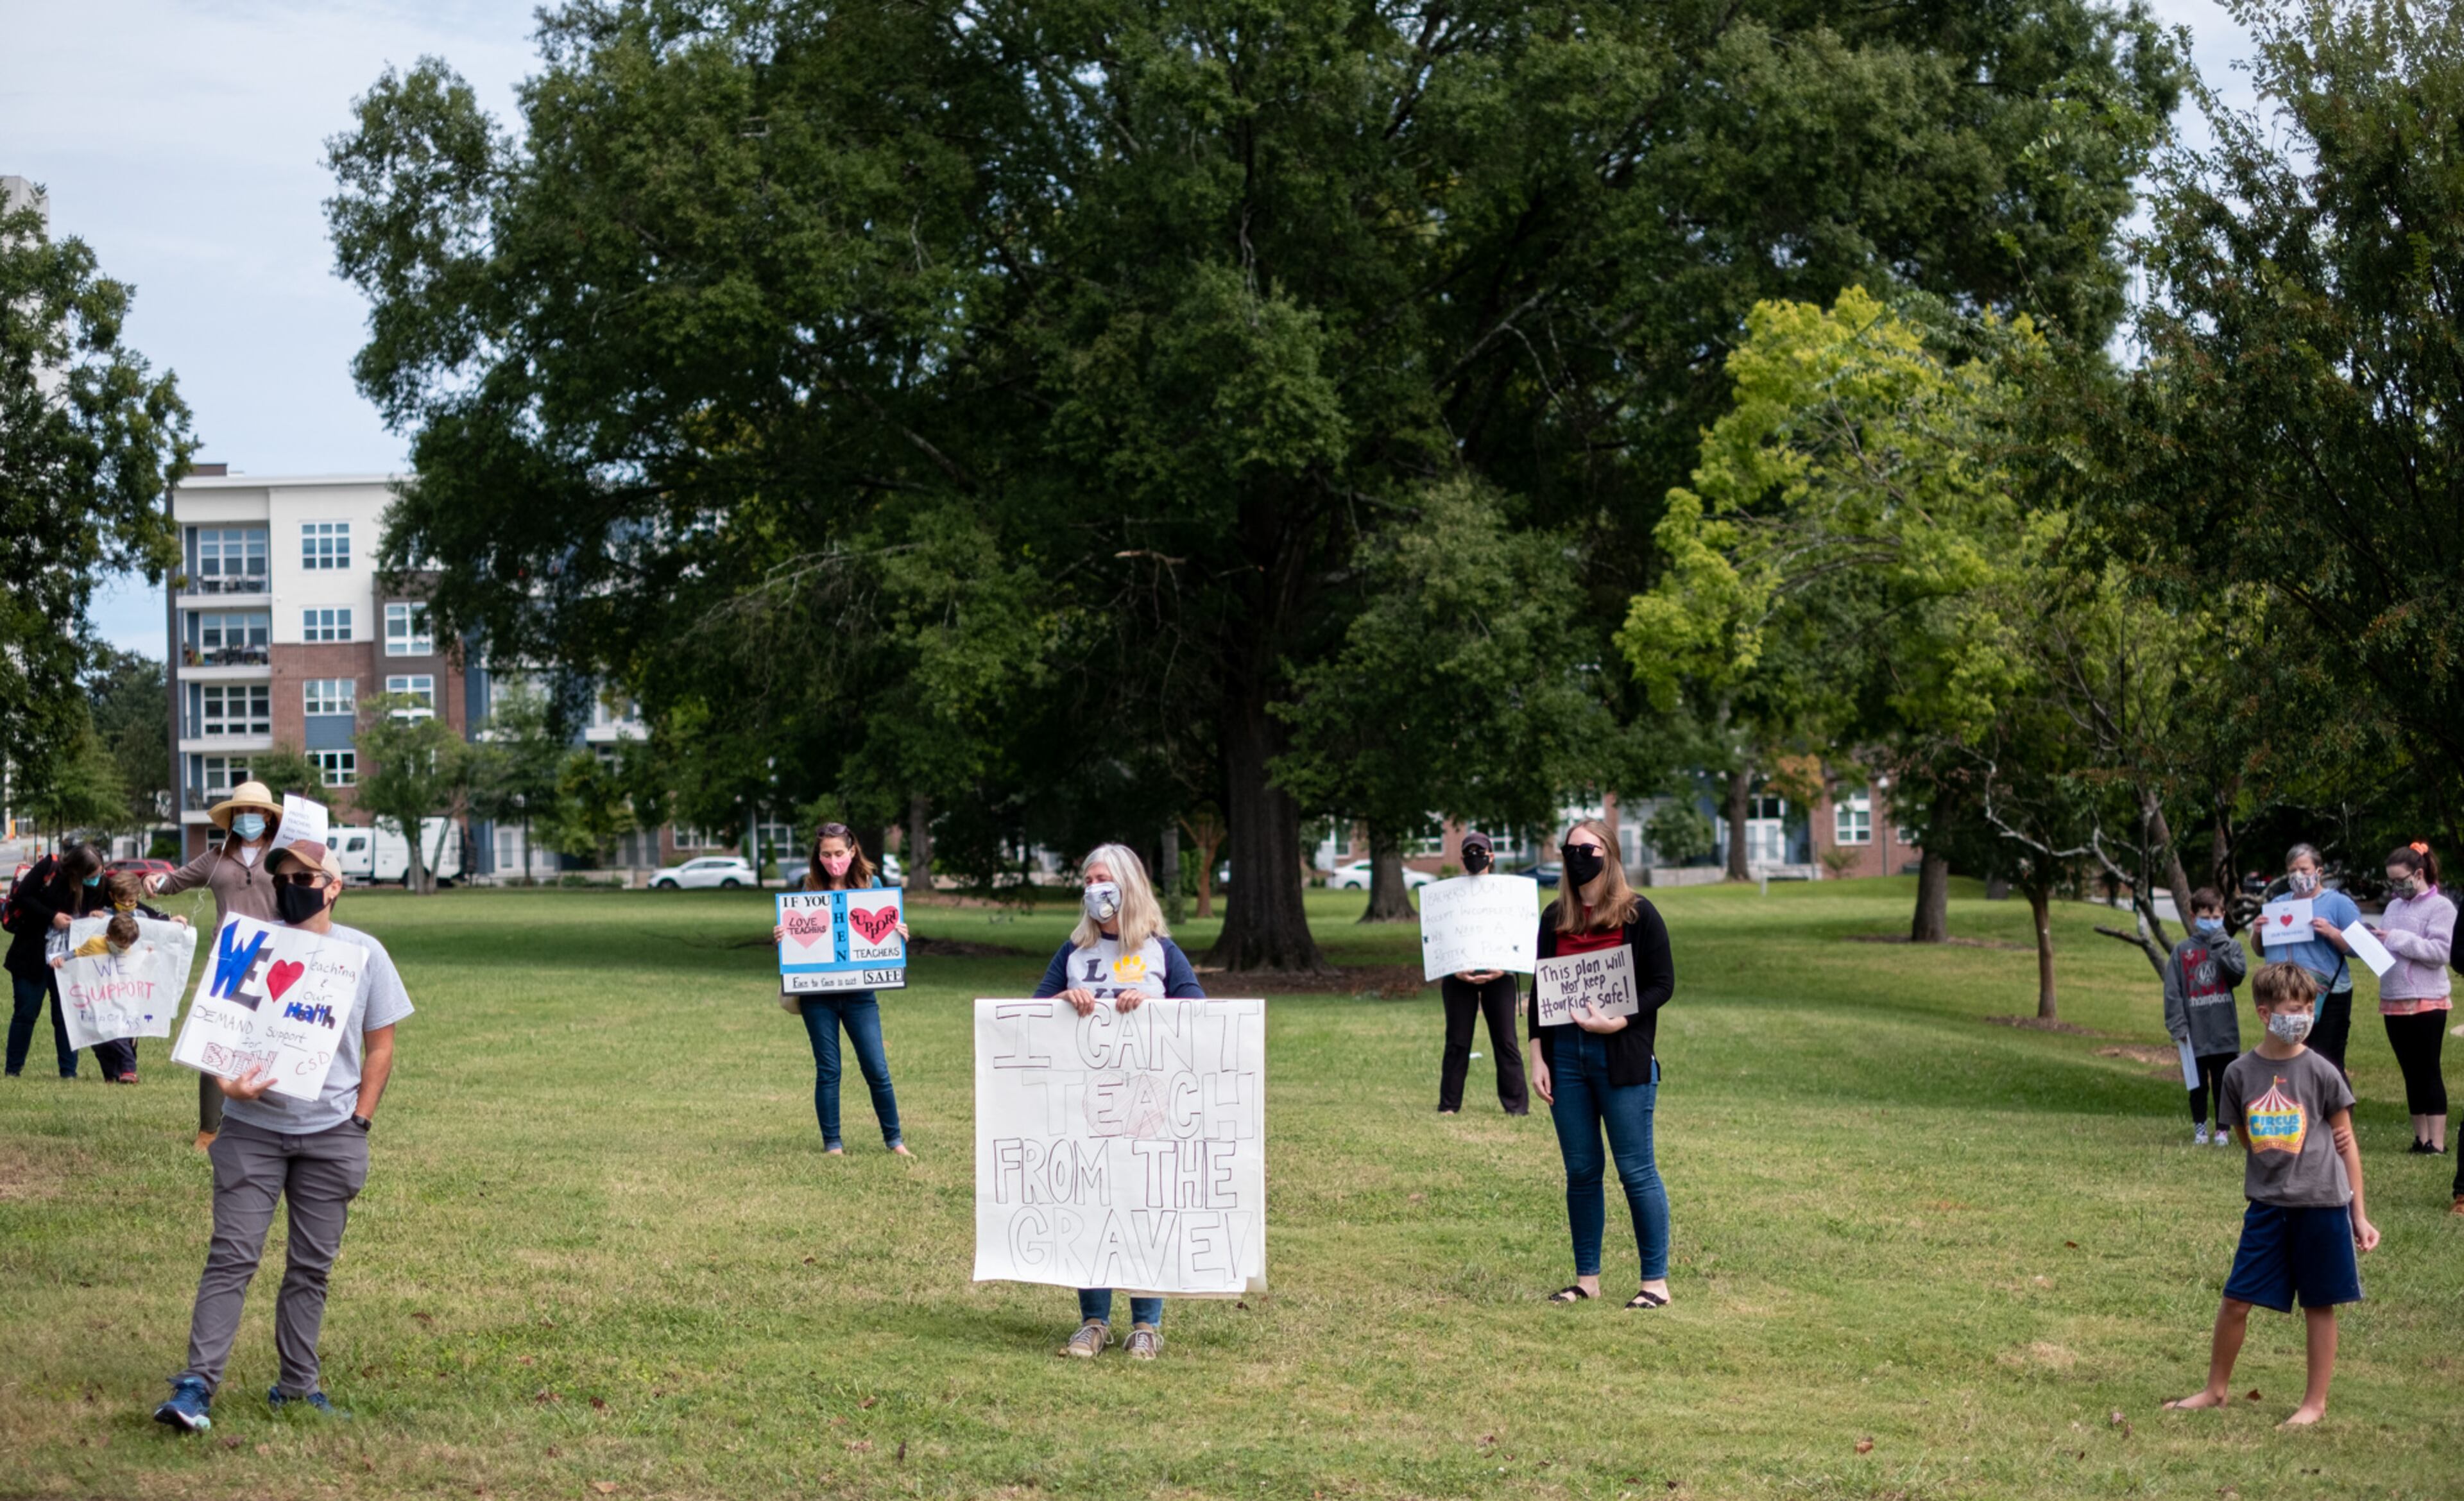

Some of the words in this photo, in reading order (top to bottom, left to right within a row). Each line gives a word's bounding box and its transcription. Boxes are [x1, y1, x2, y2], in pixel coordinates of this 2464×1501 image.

[783, 896, 798, 907] IF
[804, 895, 830, 907] YOU
[789, 917, 817, 927] LOVE
[833, 893, 848, 962] THEN
[849, 909, 898, 939] SUPPORT
[92, 956, 130, 977] WE
[210, 918, 275, 1012] WE
[305, 950, 356, 983] Teaching
[853, 947, 900, 959] TEACHERS
[1540, 965, 1570, 982] This
[1575, 959, 1600, 982] plan
[69, 981, 155, 1009] SUPPORT
[80, 1010, 141, 1029] TEACRS
[193, 1005, 254, 1034] DEMAND
[993, 1002, 1053, 1069] I
[1075, 999, 1260, 1073] CAN'T
[2250, 1114, 2300, 1129] CIRCUS
[993, 1138, 1111, 1206] FROM
[1133, 1140, 1237, 1209] THE
[1008, 1206, 1253, 1289] GRAVE!
